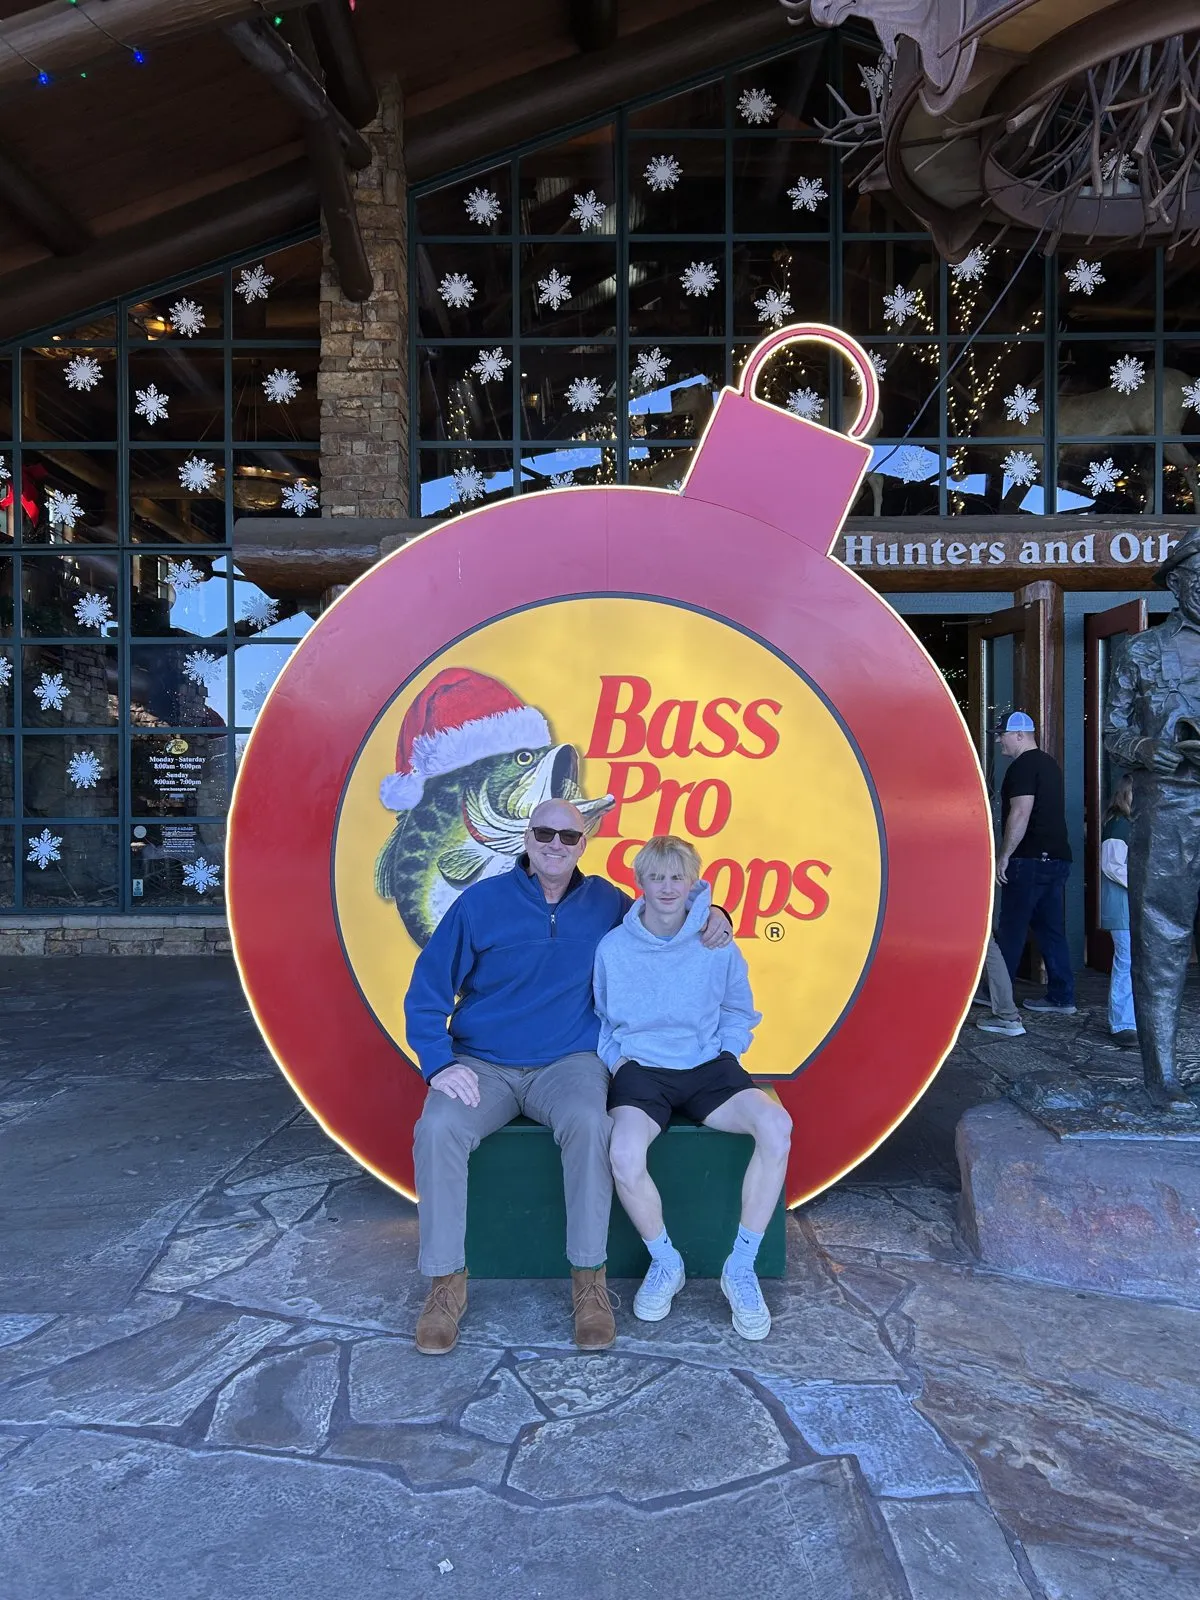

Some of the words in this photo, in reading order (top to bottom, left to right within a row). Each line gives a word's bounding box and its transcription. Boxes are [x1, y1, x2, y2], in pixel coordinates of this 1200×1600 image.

[843, 535, 1006, 565] Hunters
[1019, 533, 1096, 564] and
[1109, 532, 1180, 563] Oth
[584, 675, 783, 759] Bass
[149, 756, 175, 764] Monday
[178, 756, 206, 764] Saturday
[166, 772, 189, 780] Sunday
[596, 762, 732, 838] Pro
[606, 839, 832, 938] Sops
